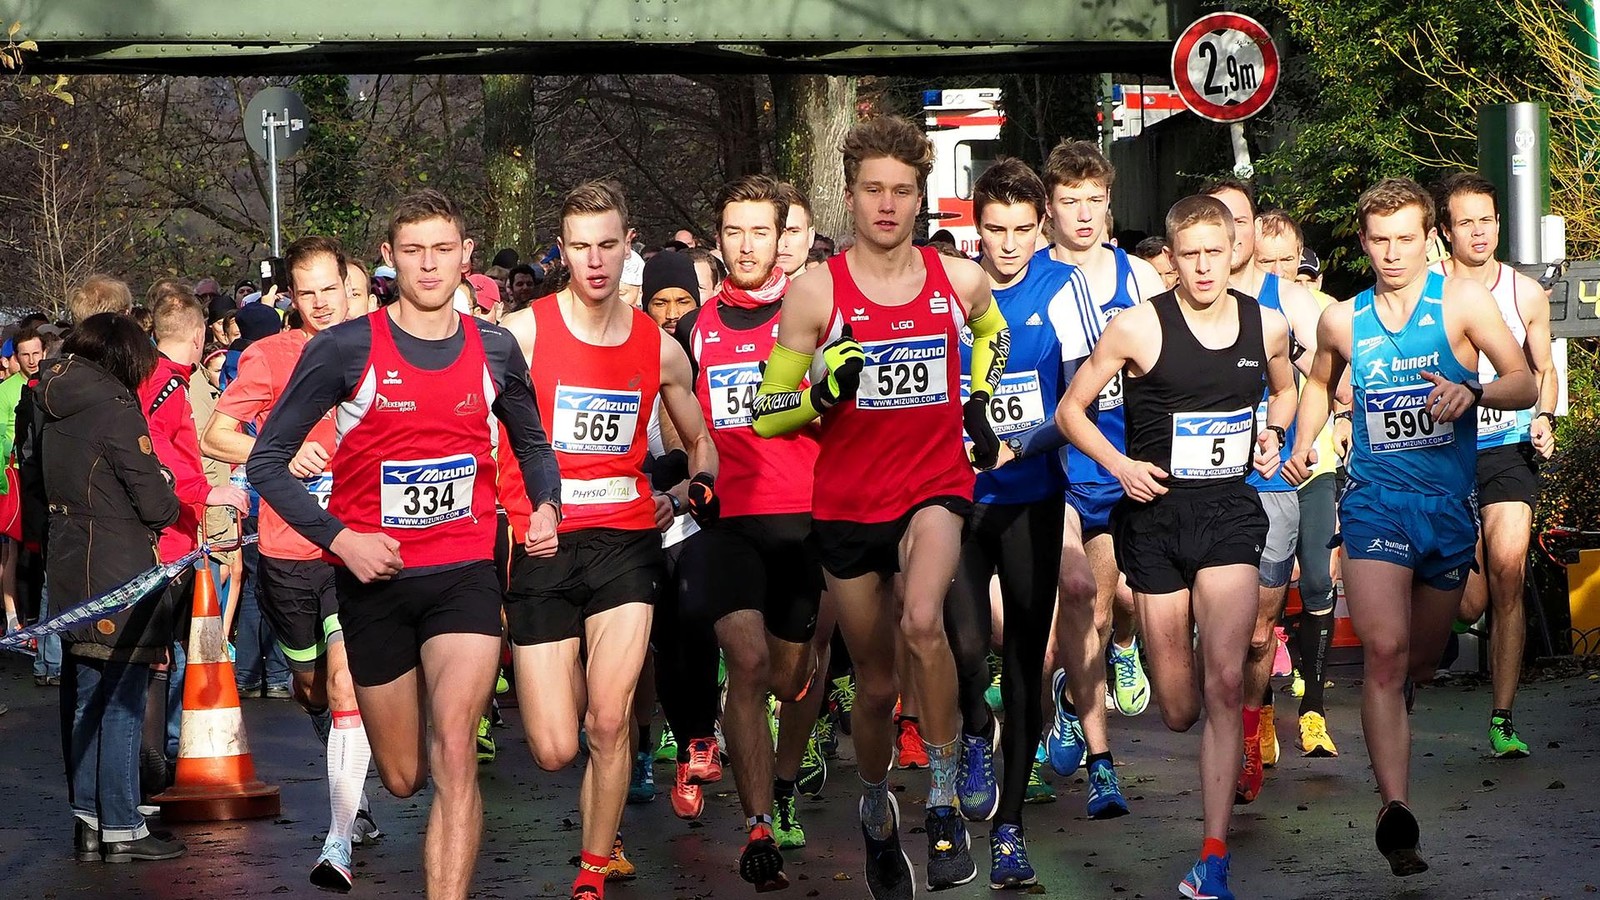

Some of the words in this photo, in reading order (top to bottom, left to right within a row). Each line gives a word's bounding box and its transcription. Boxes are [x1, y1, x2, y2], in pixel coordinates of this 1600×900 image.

[1199, 41, 1257, 97] 2,9m
[891, 320, 915, 330] LGO
[735, 343, 756, 353] LGO
[1391, 351, 1440, 372] bunert
[877, 362, 929, 396] 529
[872, 395, 936, 406] WWW.MIZUNO.COM
[573, 411, 621, 442] 565
[1383, 408, 1434, 440] 590
[566, 443, 622, 453] WWW.MIZUNO.COM
[1383, 436, 1443, 449] WWW.MIZUNO.COM
[1210, 438, 1226, 467] 5
[1186, 465, 1244, 477] WWW.MIZUNO.COM
[403, 482, 455, 516] 334
[397, 510, 460, 525] WWW.MIZUNO.COM
[1384, 539, 1410, 552] bunert
